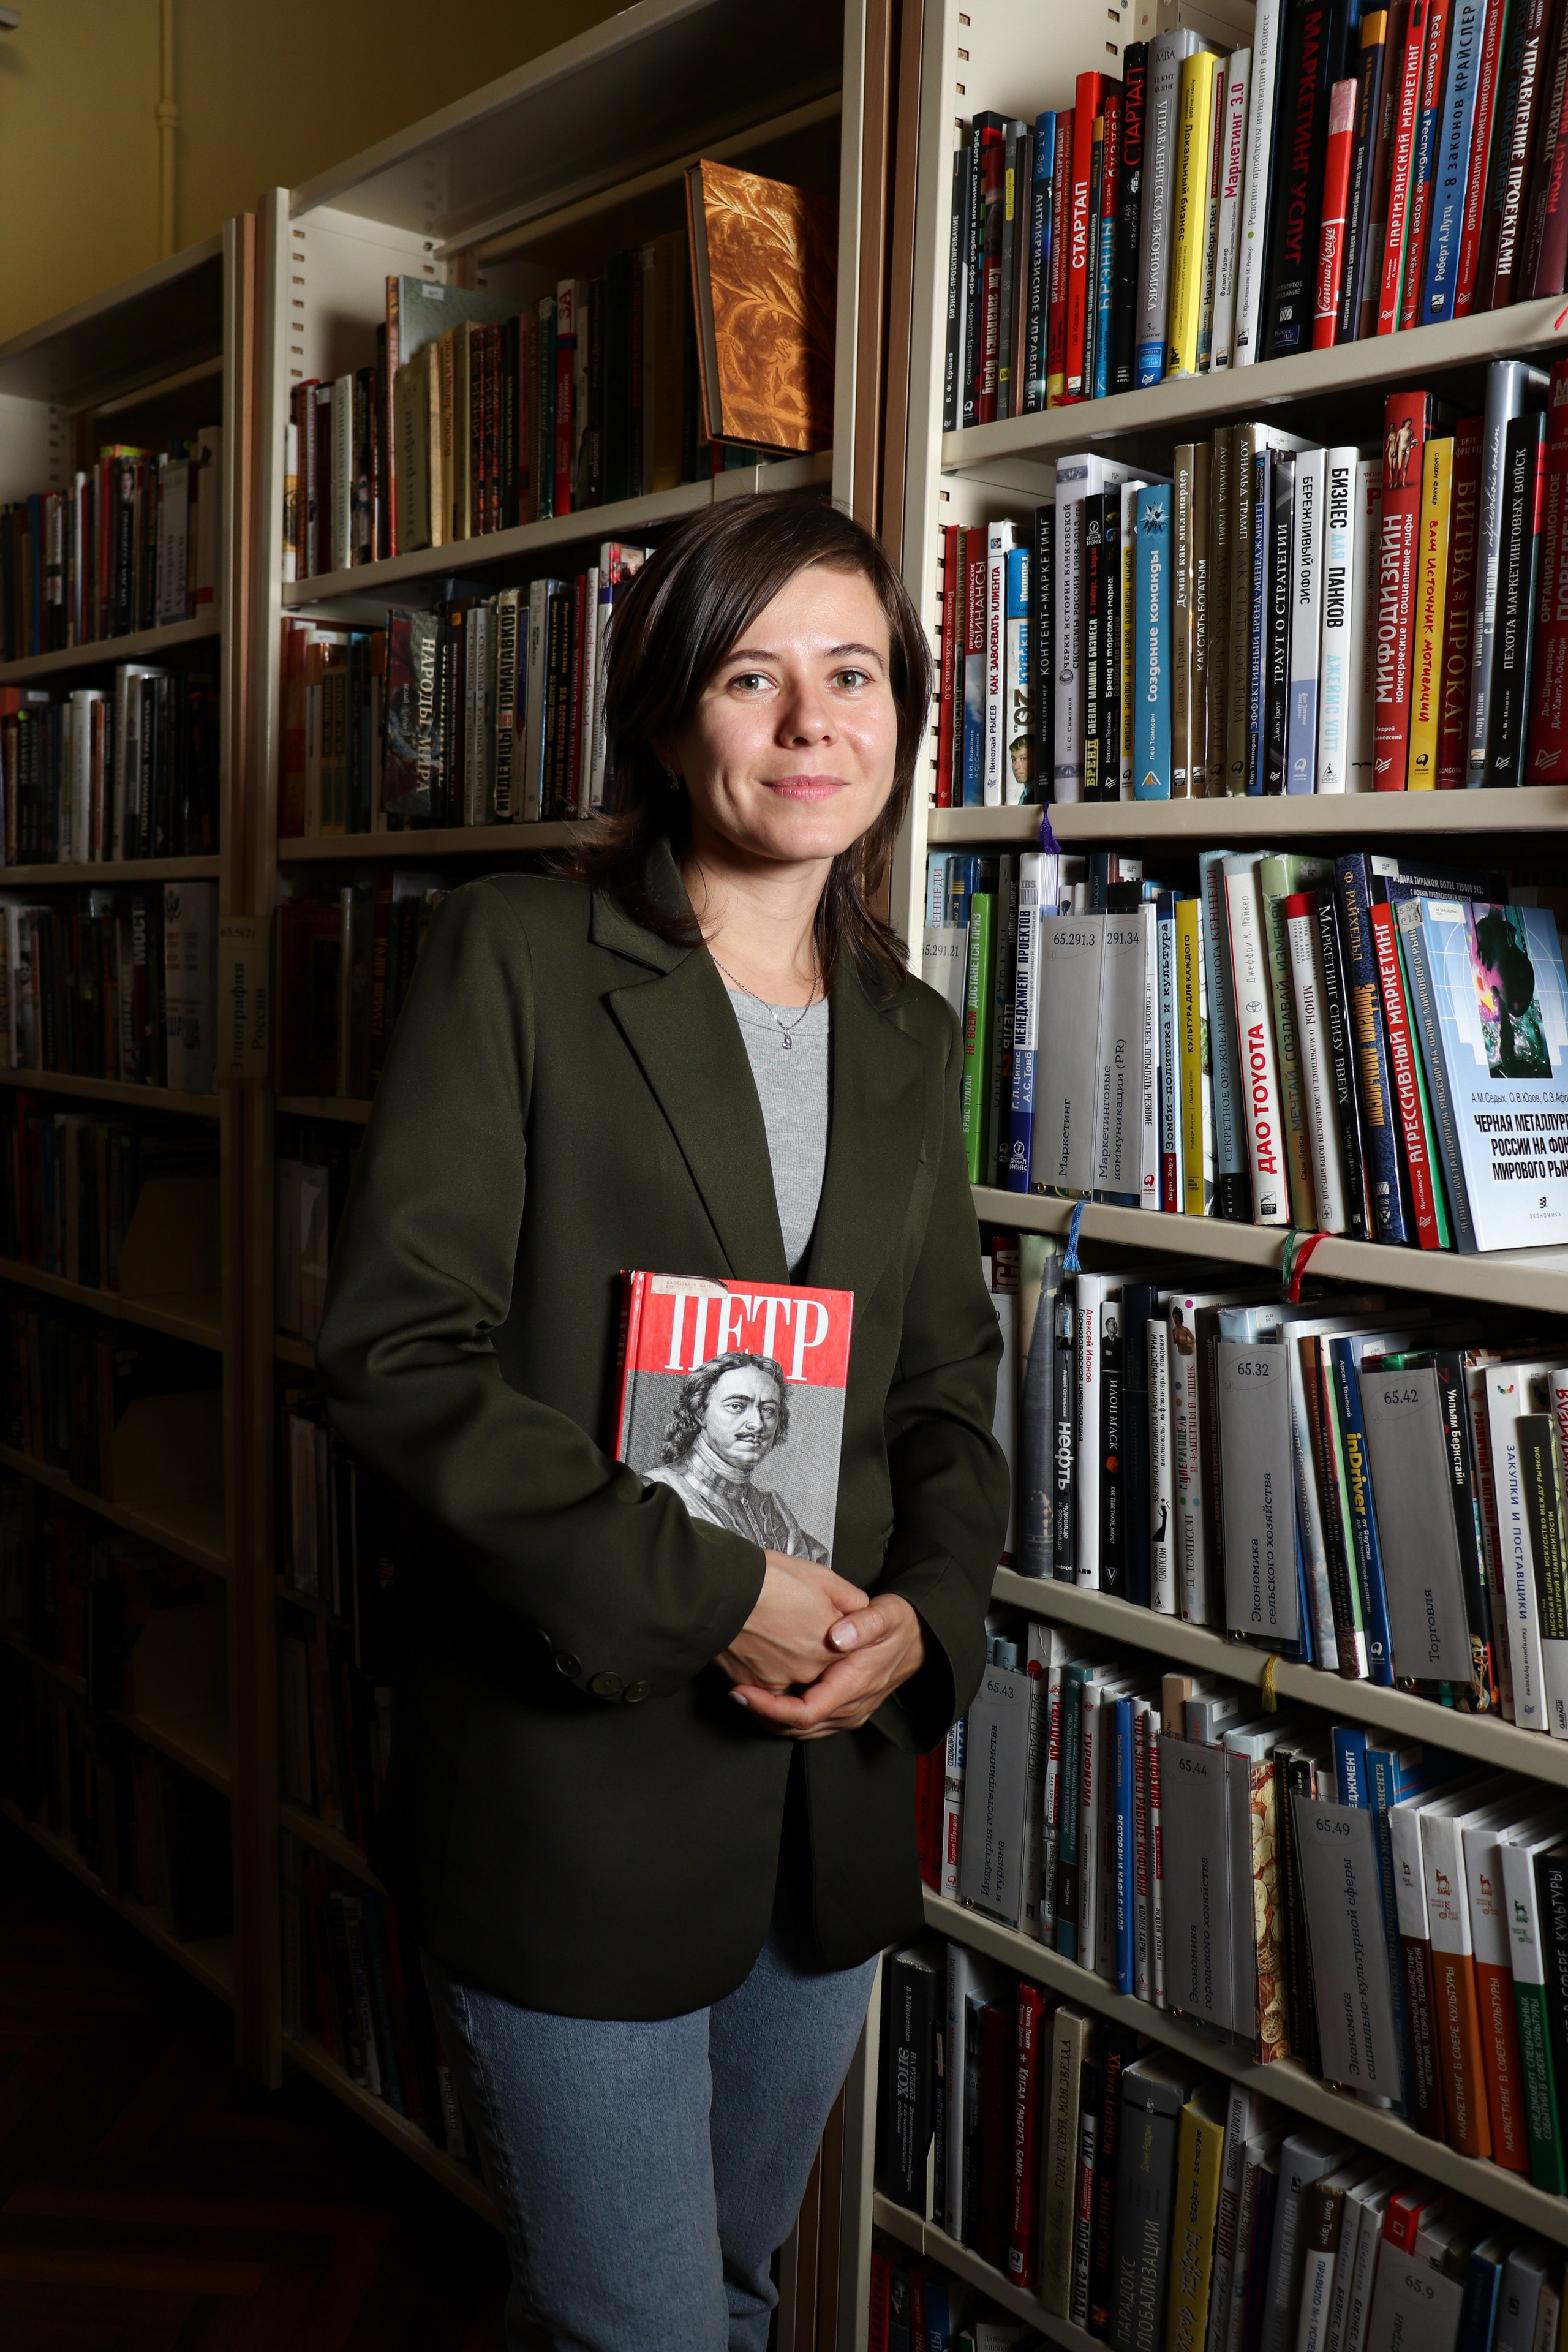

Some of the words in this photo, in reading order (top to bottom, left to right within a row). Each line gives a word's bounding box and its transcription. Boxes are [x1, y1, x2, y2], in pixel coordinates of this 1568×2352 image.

[1430, 13, 1444, 39] Всё
[1430, 41, 1438, 50] о
[1229, 82, 1246, 107] 3.0
[1291, 8, 1322, 175] МАРКЕТИНГ
[1423, 52, 1439, 107] бизнесе
[1510, 34, 1540, 162] УПРАВЛЕНИЕ
[1122, 66, 1147, 166] СТАРТАП
[1387, 132, 1410, 248] ПАРТИЗАНСКИЙ
[1400, 43, 1419, 127] МАРКЕТИНГ
[1150, 99, 1169, 222] УПРАВЛЕНЧЕСКАЯ
[1180, 124, 1193, 195] Локальный
[1223, 111, 1244, 199] Маркетинг
[1414, 118, 1432, 194] Республике
[1071, 181, 1087, 268] СТАРТАП
[1177, 197, 1189, 241] бизнес
[1284, 179, 1308, 265] УСЛУГ
[1409, 195, 1424, 234] Корея
[1496, 163, 1524, 277] ПРОЕКТАМИ
[949, 214, 959, 319] БИЗНЕС-ПРОЕКТИРОВАНИЕ
[968, 264, 976, 295] сфере
[1030, 194, 1044, 312] АНТИКРИЗИСНОЕ
[1144, 224, 1161, 311] ЭКОНОМИКА
[1220, 247, 1229, 271] Котлер
[1219, 273, 1227, 296] Филип
[965, 339, 974, 385] Еременко
[1027, 315, 1039, 408] УПРАВЛЕНИЕ
[1329, 467, 1349, 529] БИЗНЕС
[1511, 447, 1526, 493] ВОЙСК
[1300, 476, 1314, 567] БЕРЕЖЛИВЫЙ
[1331, 533, 1346, 559] ДЛЯ
[1426, 520, 1439, 552] ВАШ
[1451, 480, 1476, 585] БИТВА
[1148, 549, 1163, 622] команды
[1275, 522, 1288, 614] СТРАТЕГИИ
[1505, 497, 1523, 614] МАРКЕТИНГОВЫХ
[973, 561, 986, 649] ФИНАНСЫ
[1039, 518, 1050, 675] КОНТЕНТ-МАРКЕТИНГ
[1299, 570, 1311, 605] ОФИС
[1326, 566, 1346, 628] ПАНКОВ
[1372, 513, 1403, 703] МИФОДИЗАЙН
[1422, 559, 1438, 634] ИСТОЧНИК
[1275, 619, 1286, 629] О
[1502, 619, 1517, 669] ПЕХОТА
[416, 637, 435, 725] НАРОДЫ
[497, 604, 518, 713] ТОМАГАВКОВ
[1147, 627, 1161, 702] Создание
[1273, 634, 1285, 684] ТРАУТ
[1418, 639, 1433, 722] МОТИВАЦИИ
[1443, 608, 1469, 740] ПРОКАТ
[413, 734, 432, 793] МИРА
[1084, 738, 1099, 787] БРЕНД
[1020, 879, 1036, 889] IBS
[970, 912, 981, 939] ПРИЗ
[1017, 910, 1030, 963] ПРОЕКТОВ
[1053, 932, 1095, 946] 65.291.3
[968, 943, 979, 1008] ДОСТАНЕТСЯ
[1374, 921, 1403, 1025] МАРКЕТИНГ
[229, 962, 247, 1074] Этнография
[251, 988, 267, 1050] России
[967, 1011, 977, 1039] ВСЕМ
[1014, 970, 1030, 1045] МЕНЕДЖМЕНТ
[1355, 983, 1379, 1043] Эффект
[966, 1042, 976, 1055] НЕ
[1114, 1038, 1126, 1069] (PR)
[1246, 1023, 1269, 1117] TOYOTA
[1360, 1047, 1386, 1127] лояльности
[1389, 1029, 1423, 1164] АГРЕССИВНЫЙ
[1058, 1098, 1071, 1177] Маркетинг
[1098, 1065, 1112, 1178] Маркетинговые
[1112, 1072, 1125, 1180] коммуникации
[1254, 1120, 1277, 1175] ДАО
[1474, 1113, 1512, 1133] ЧЕРНАЯ
[1491, 1136, 1531, 1157] РОССИИ
[1532, 1136, 1547, 1155] НА
[1491, 1160, 1545, 1180] МИРОВОГО
[665, 1293, 829, 1381] ПЕТР
[1084, 1308, 1093, 1346] Алексей
[1084, 1349, 1093, 1382] Иванов
[1109, 1379, 1118, 1413] ИЛОН
[1237, 1362, 1269, 1376] 65.32
[1383, 1389, 1419, 1404] 65.42
[1109, 1416, 1117, 1449] МАСК
[1444, 1389, 1460, 1428] Уильям
[1346, 1432, 1369, 1516] inDriver
[1449, 1430, 1467, 1485] Бернстайн
[1505, 1444, 1519, 1505] ЗАКУПКИ
[1261, 1472, 1274, 1547] хозяйства
[1510, 1512, 1520, 1521] И
[1251, 1538, 1261, 1622] Экономика
[1264, 1551, 1276, 1624] сельского
[1512, 1527, 1528, 1619] ПОСТАВЩИКИ
[1423, 1588, 1441, 1662] Торговля
[985, 1679, 1016, 1698] 65.43
[984, 1725, 999, 1825] гостеприимства
[1080, 1733, 1094, 1807] ТУРФИРМА
[1177, 1757, 1209, 1777] 65.44
[949, 1814, 958, 1842] Шредер
[1314, 1816, 1351, 1836] 65.49
[980, 1828, 993, 1896] Индустрия
[994, 1841, 1006, 1891] туризма
[1199, 1856, 1210, 1927] хозяйства
[1341, 1857, 1359, 1906] сферы
[995, 1894, 1001, 1902] и
[1189, 1924, 1199, 2003] Экономика
[1202, 1930, 1213, 2009] городского
[1445, 1966, 1459, 2022] КУЛЬТУРЫ
[1347, 1909, 1378, 2081] социально-культурной
[1058, 2039, 1072, 2086] ЗВЕЗДА
[1340, 1991, 1360, 2076] Экономика
[1450, 2024, 1461, 2059] СФЕРЕ
[895, 2046, 910, 2098] ЭПОХ
[1057, 2087, 1070, 2115] МОЯ
[1055, 2117, 1069, 2152] ГОРИ,
[1453, 2072, 1468, 2139] МАРКЕТИНГ
[1054, 2155, 1067, 2190] ГОРИ,
[1214, 2188, 1242, 2261] ИСПАНИЯ
[1116, 2255, 1138, 2343] ПАРАДОКС
[1134, 2219, 1162, 2352] ГЛОБАЛИЗАЦИИ
[1402, 2274, 1437, 2300] 65.9
